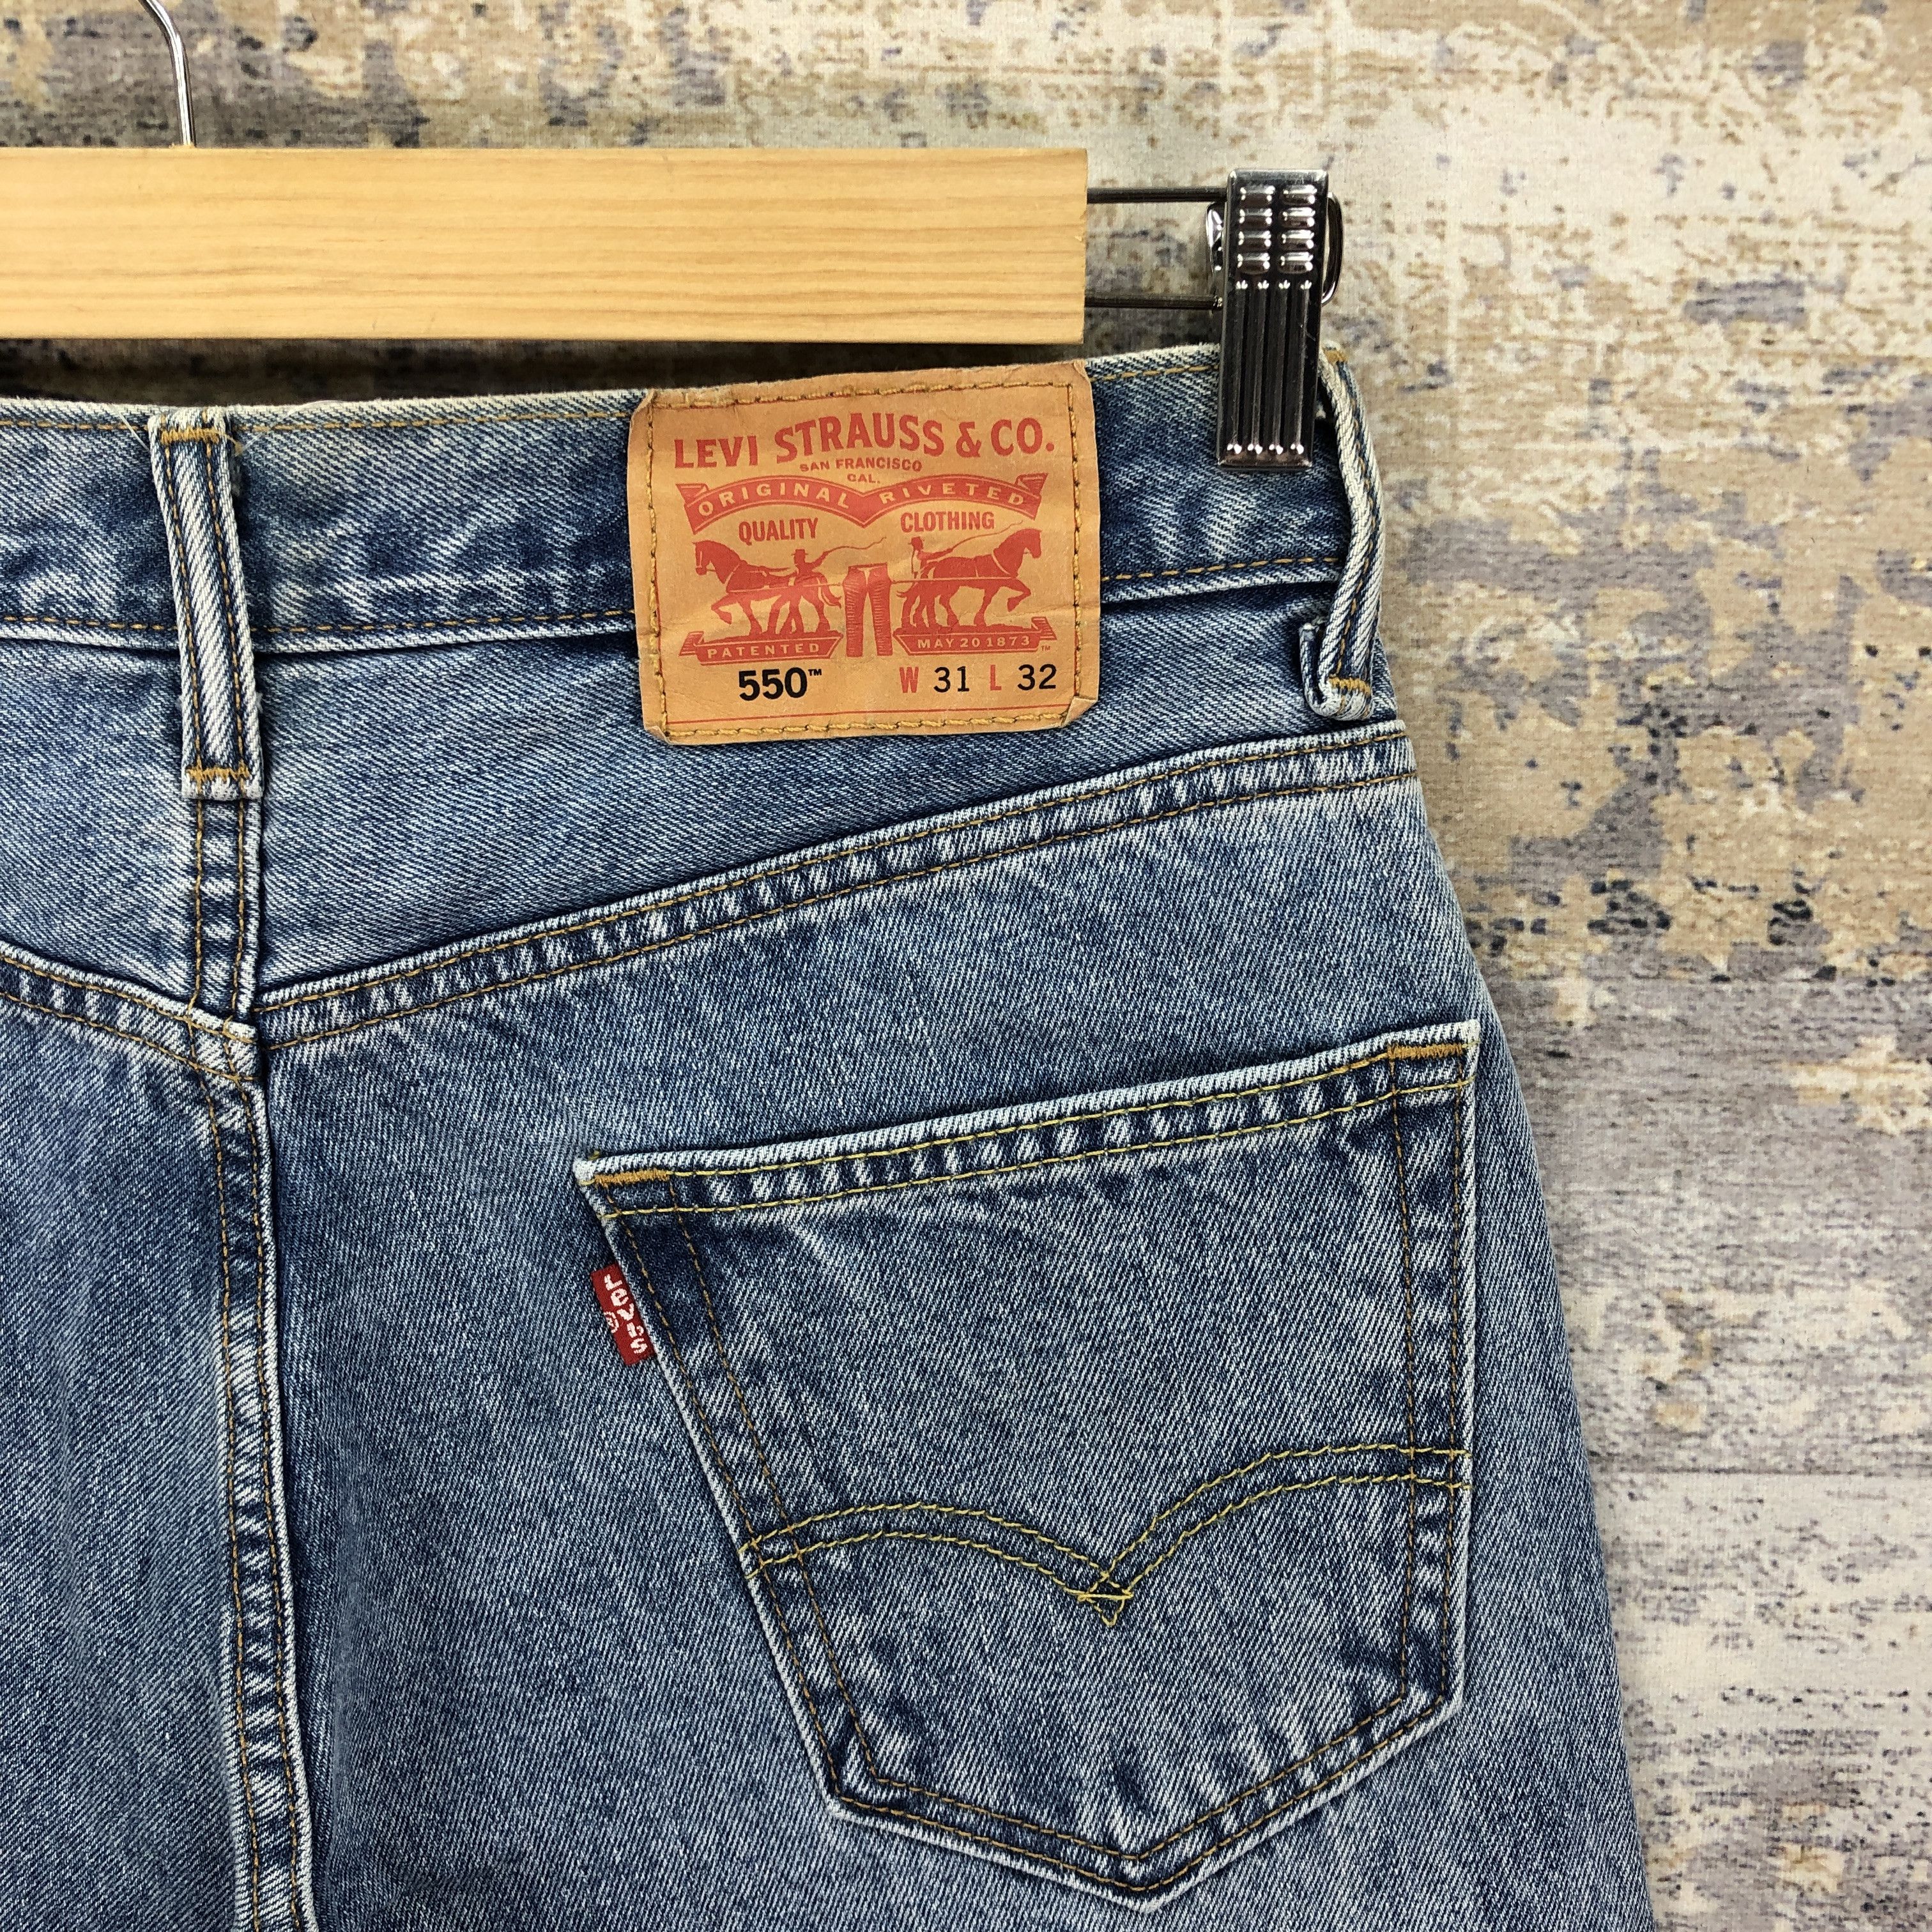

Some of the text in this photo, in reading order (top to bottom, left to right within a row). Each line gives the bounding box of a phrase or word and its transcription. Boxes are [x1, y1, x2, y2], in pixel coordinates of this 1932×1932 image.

[674, 412, 1055, 468] LEVI STRAUSS & CO.
[800, 457, 922, 472] SAN FRANCISCO
[847, 473, 880, 484] CAL.
[698, 482, 1023, 516] ORIGINAL RIVETED
[738, 511, 995, 546] QUALITY CLOTHING
[707, 643, 820, 659] PATENTED
[917, 636, 1030, 649] MAY 20 1873
[899, 664, 1057, 693] W 31 L 32
